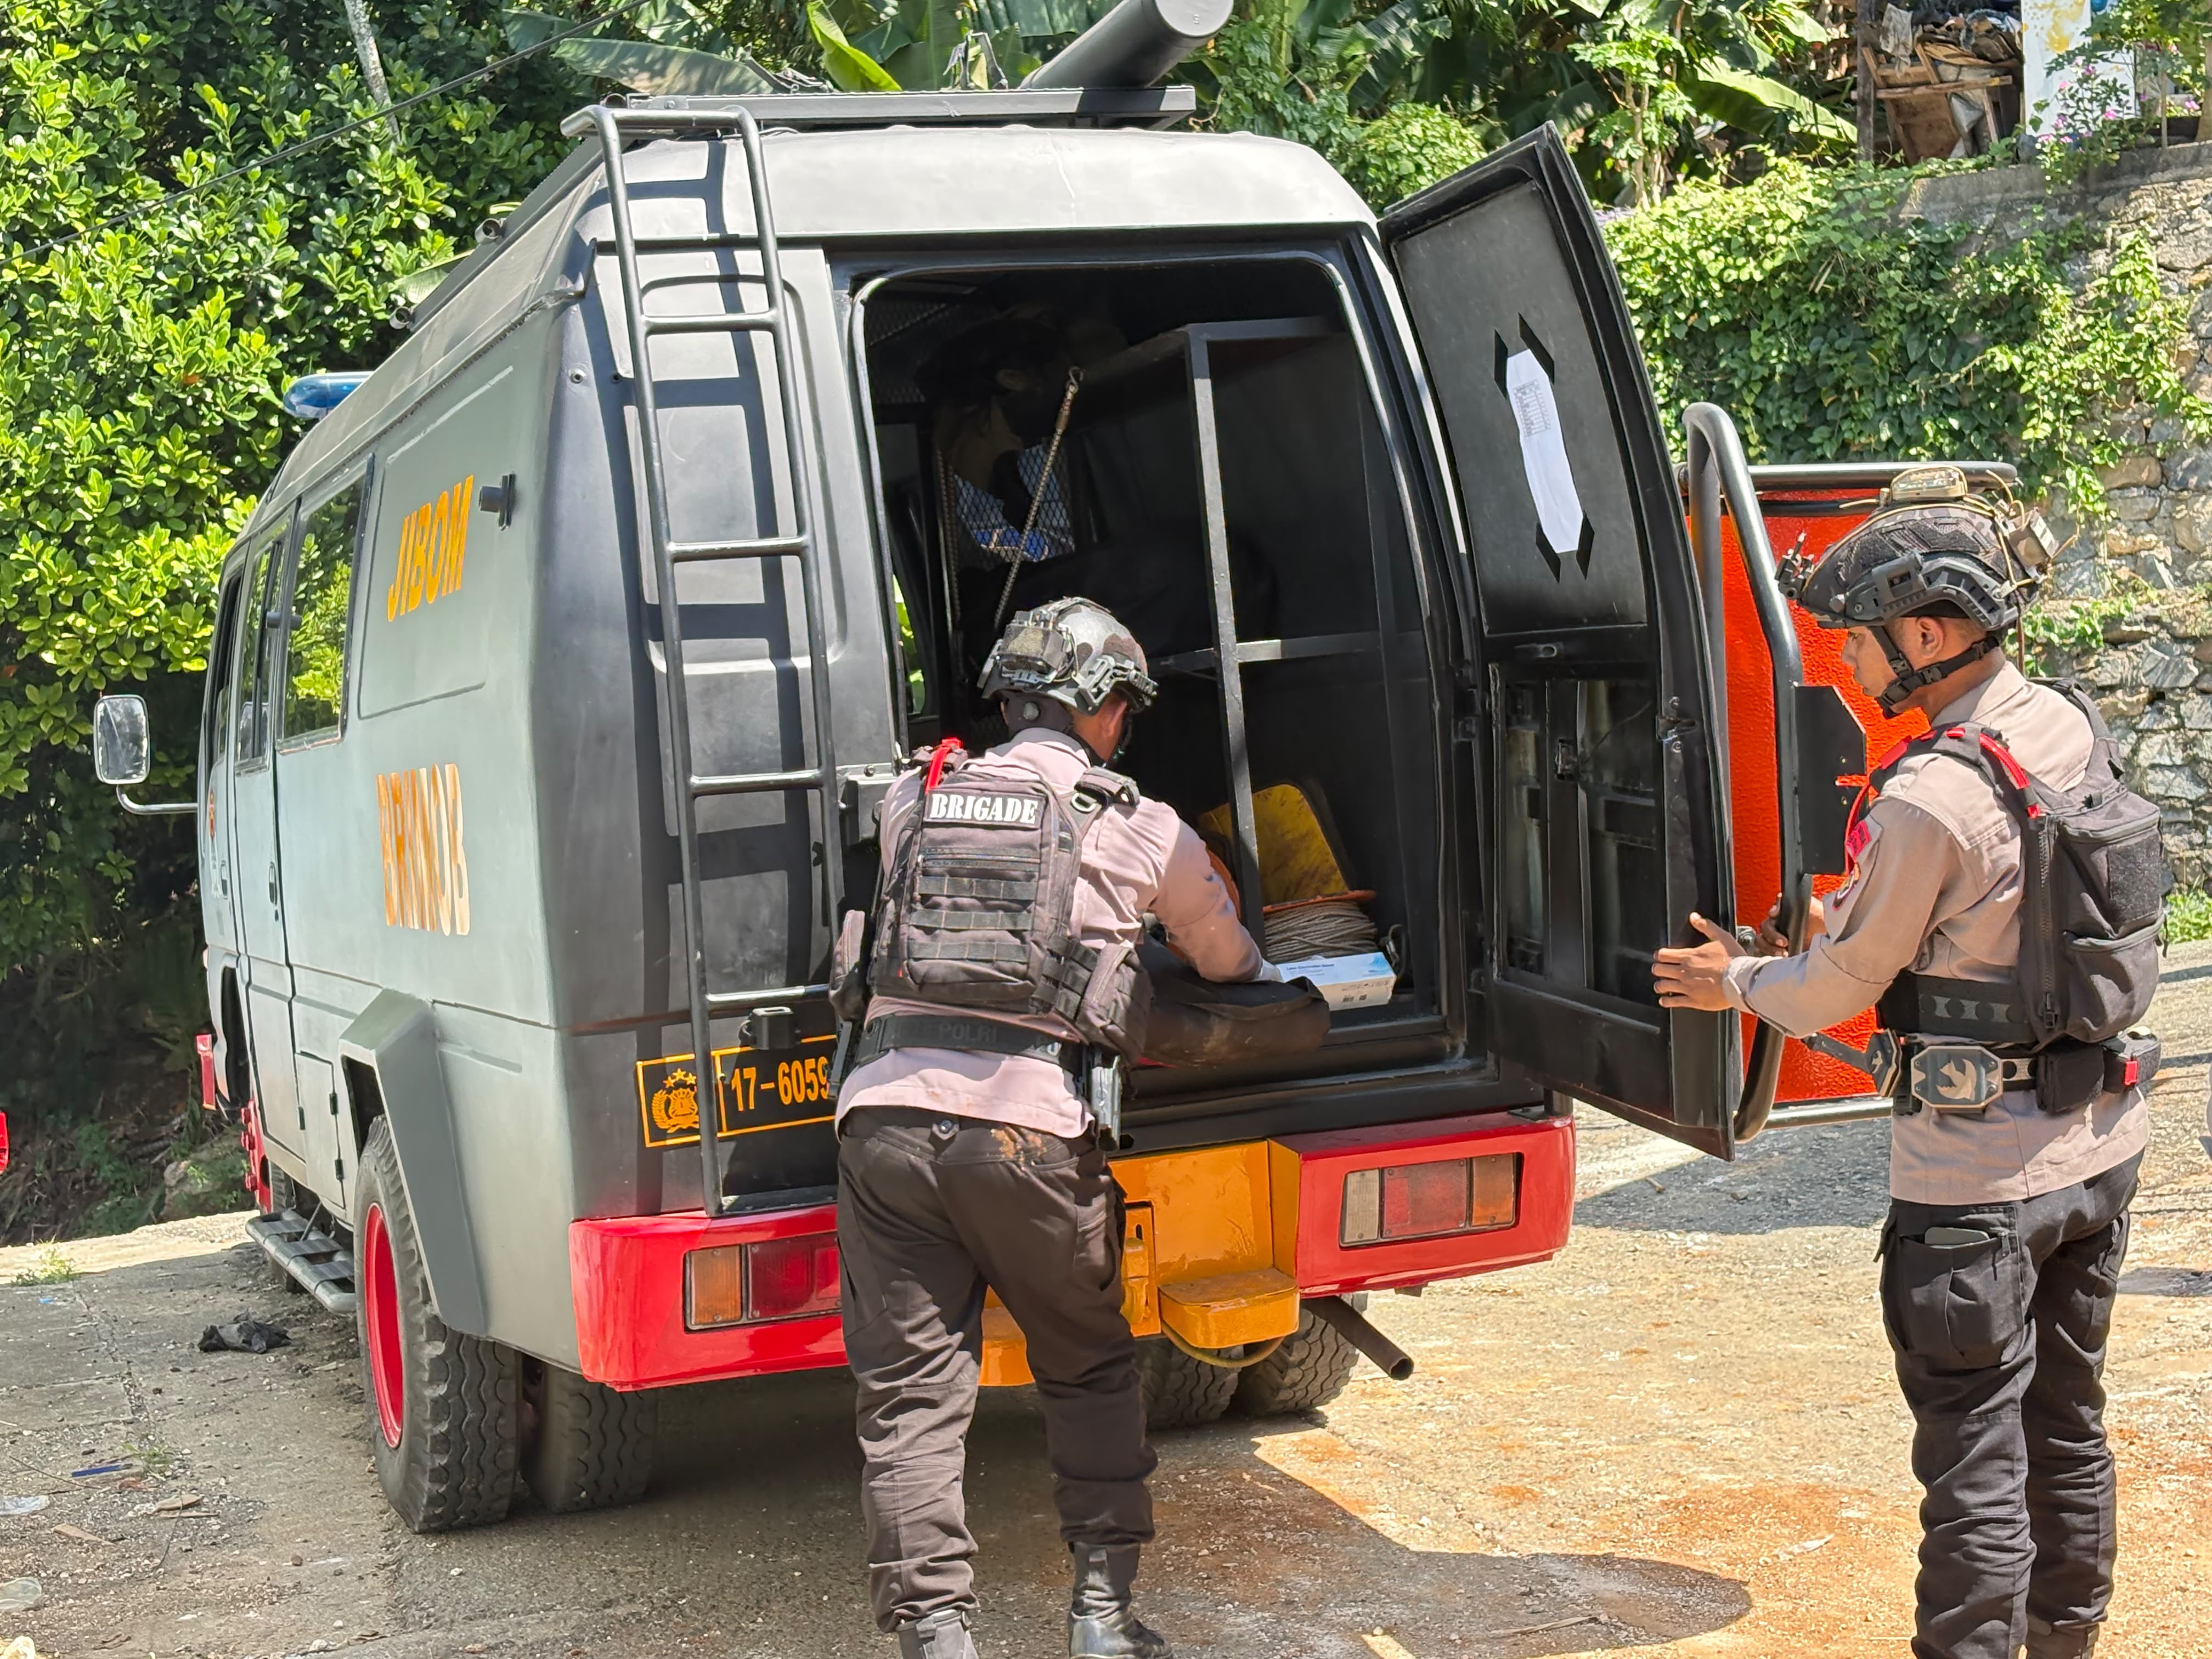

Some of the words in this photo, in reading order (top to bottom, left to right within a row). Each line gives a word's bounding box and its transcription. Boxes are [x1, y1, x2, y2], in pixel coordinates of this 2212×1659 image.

[387, 475, 473, 623] JIBOM
[929, 793, 1039, 824] BRIGADE
[376, 763, 470, 936] BRIMOB
[939, 1022, 997, 1043] POLRI
[731, 1056, 830, 1112] 17-6059
